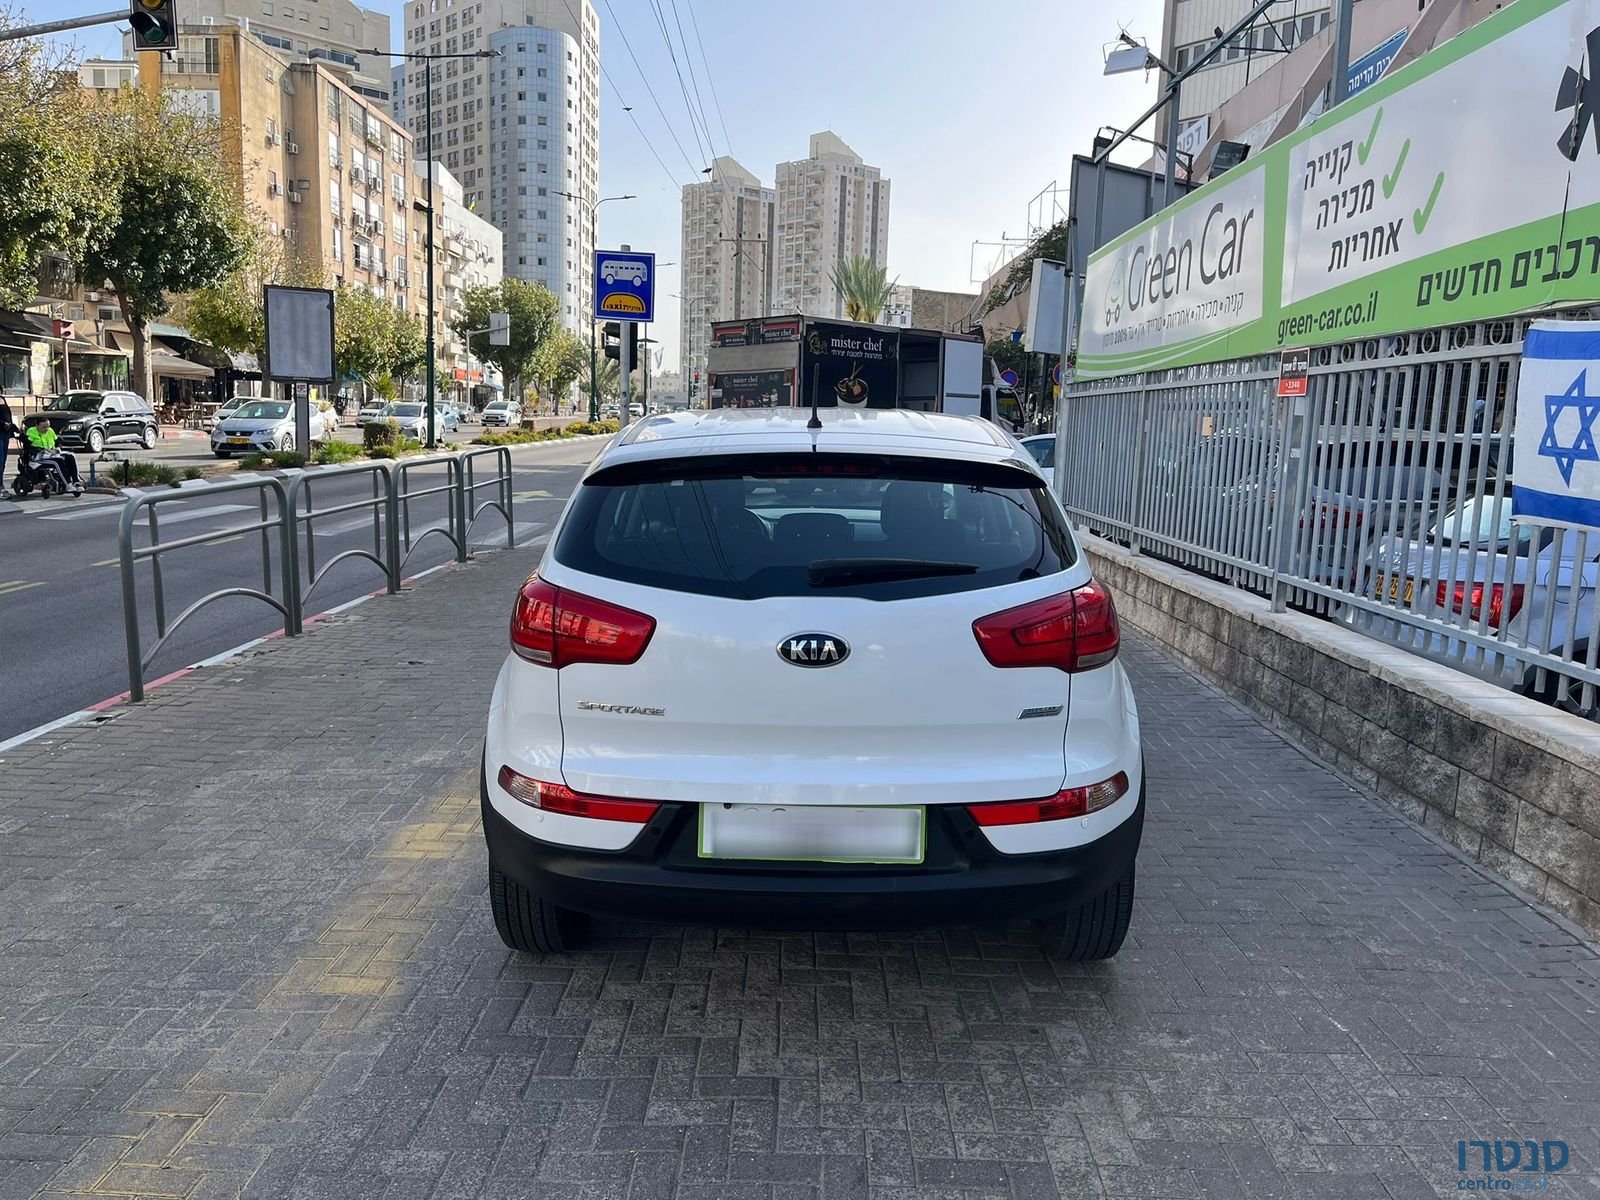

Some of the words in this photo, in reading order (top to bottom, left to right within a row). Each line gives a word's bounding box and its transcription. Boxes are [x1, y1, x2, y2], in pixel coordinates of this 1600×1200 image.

[1348, 65, 1374, 92] קדימה
[1303, 140, 1353, 191] קנייה
[1316, 178, 1375, 230] מכירה
[1128, 238, 1193, 312] Green
[1200, 202, 1254, 285] Car
[1327, 218, 1404, 273] אחריות
[1416, 258, 1502, 307] חדשים
[1195, 299, 1217, 323] מכירה
[1224, 292, 1244, 317] קניה
[1277, 290, 1379, 345] green-car.co.il
[830, 337, 861, 350] mister
[863, 337, 884, 351] chef
[790, 639, 839, 660] KIA
[577, 700, 666, 717] SPORTAGE
